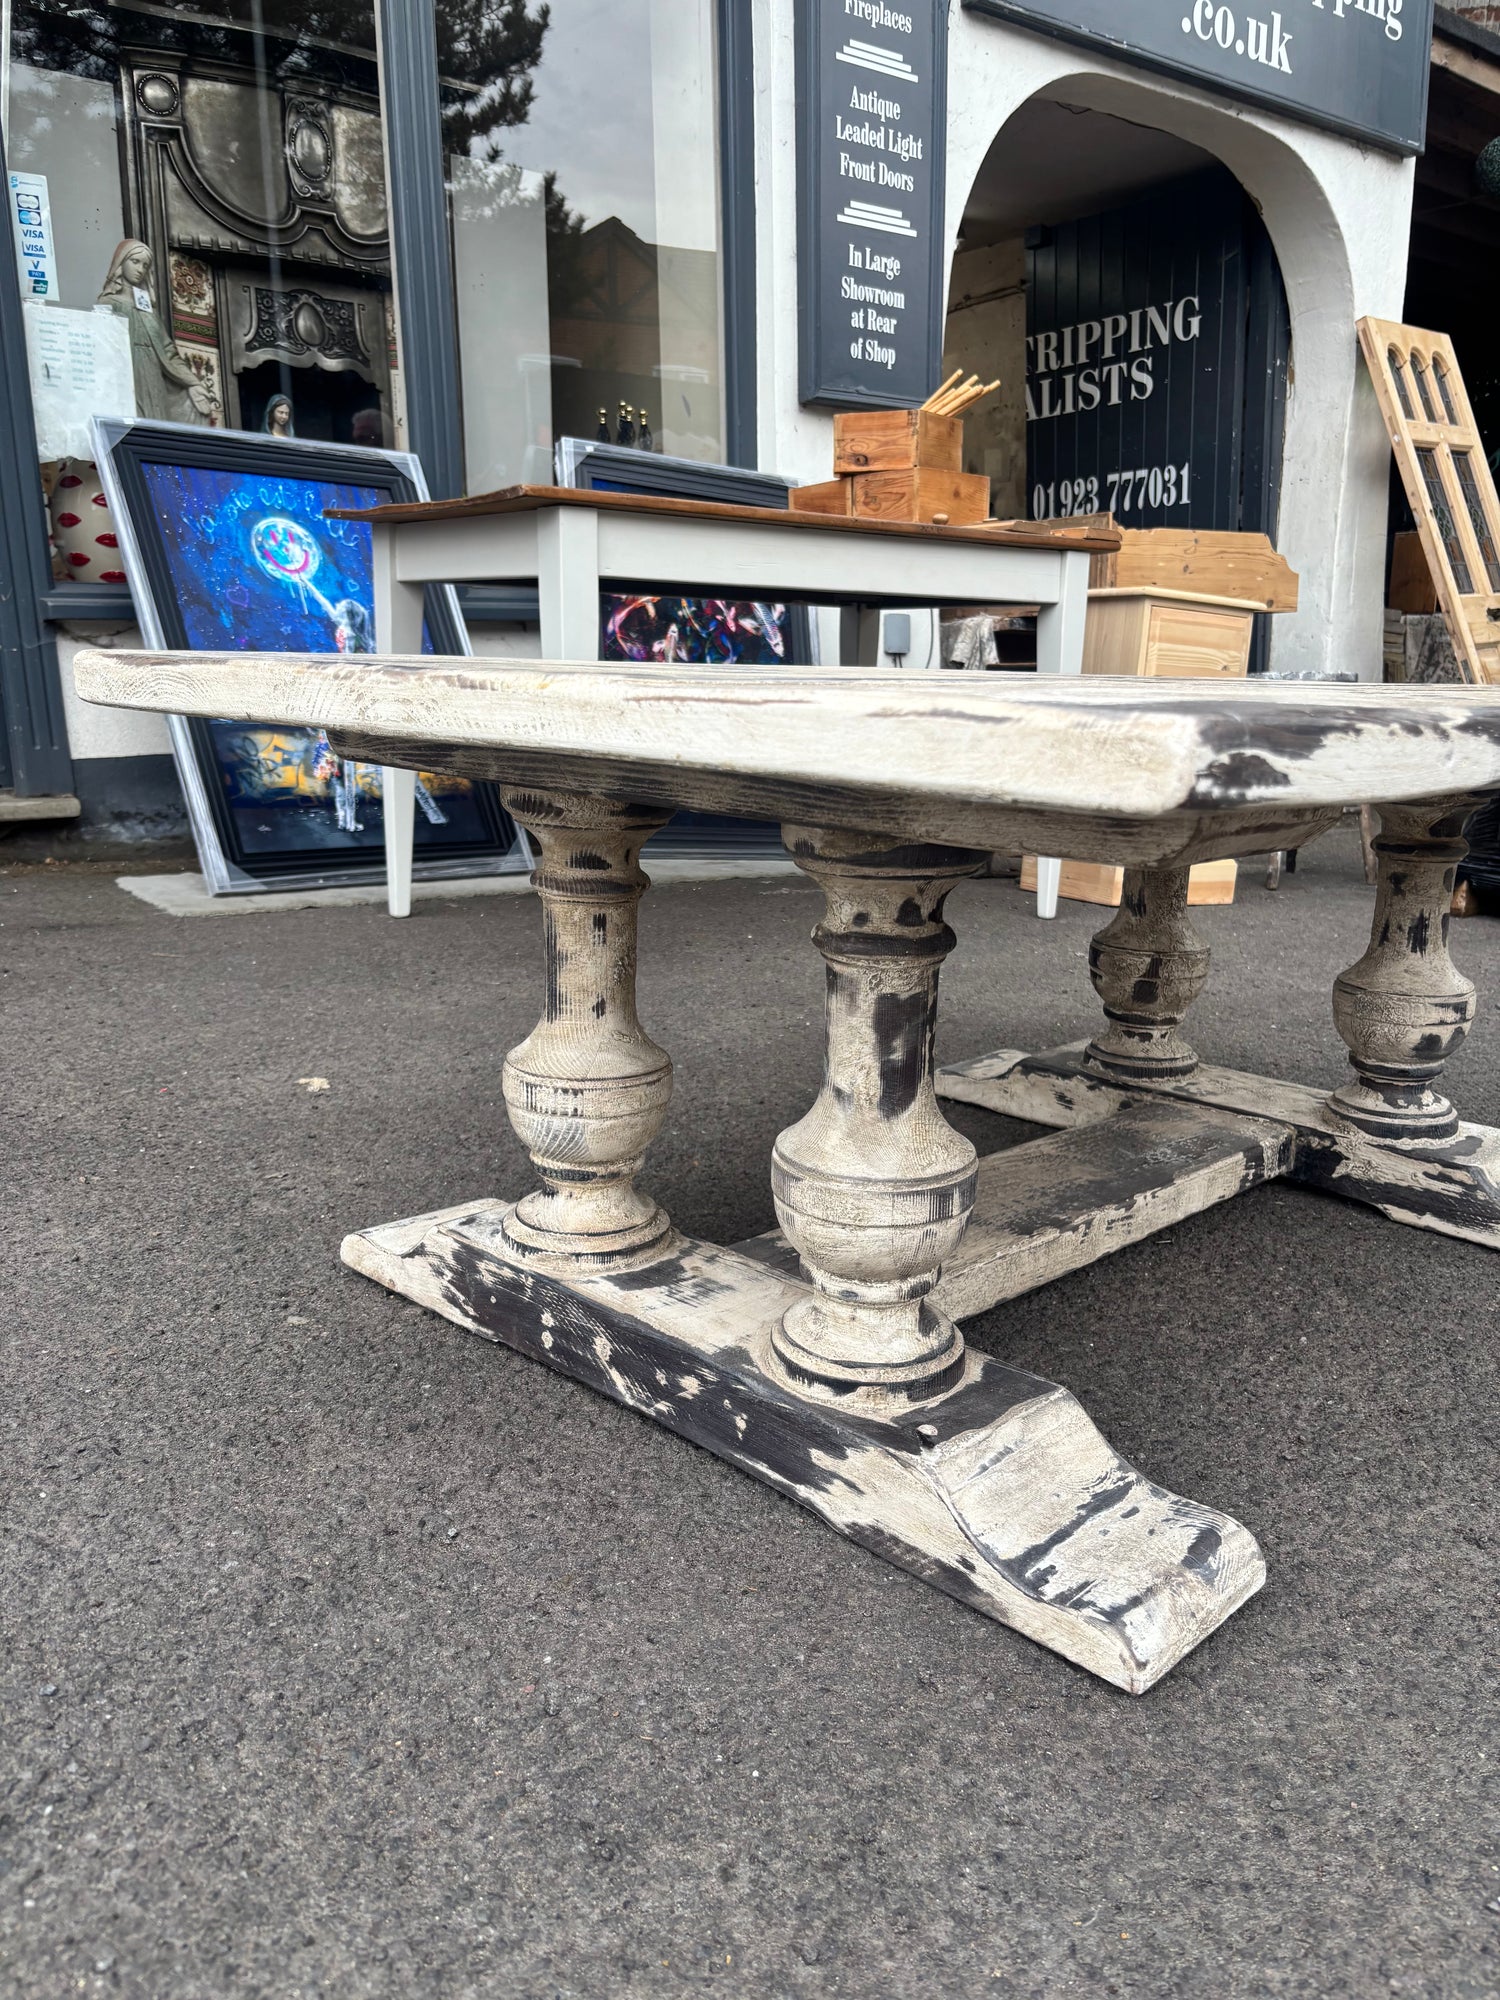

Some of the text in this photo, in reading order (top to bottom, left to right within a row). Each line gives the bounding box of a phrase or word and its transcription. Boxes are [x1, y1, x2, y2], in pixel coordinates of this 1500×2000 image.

[844, 0, 912, 34] Fireplaces
[850, 85, 901, 123] Antique
[836, 115, 923, 162] Leaded Light
[840, 152, 914, 192] Front Doors
[22, 229, 45, 239] VISA
[25, 243, 45, 253] VISA
[848, 244, 901, 280] In Large
[841, 276, 905, 310] Showroom
[851, 308, 897, 335] at Rear
[850, 337, 896, 370] of Shop
[1033, 461, 1191, 521] 01923 777031
